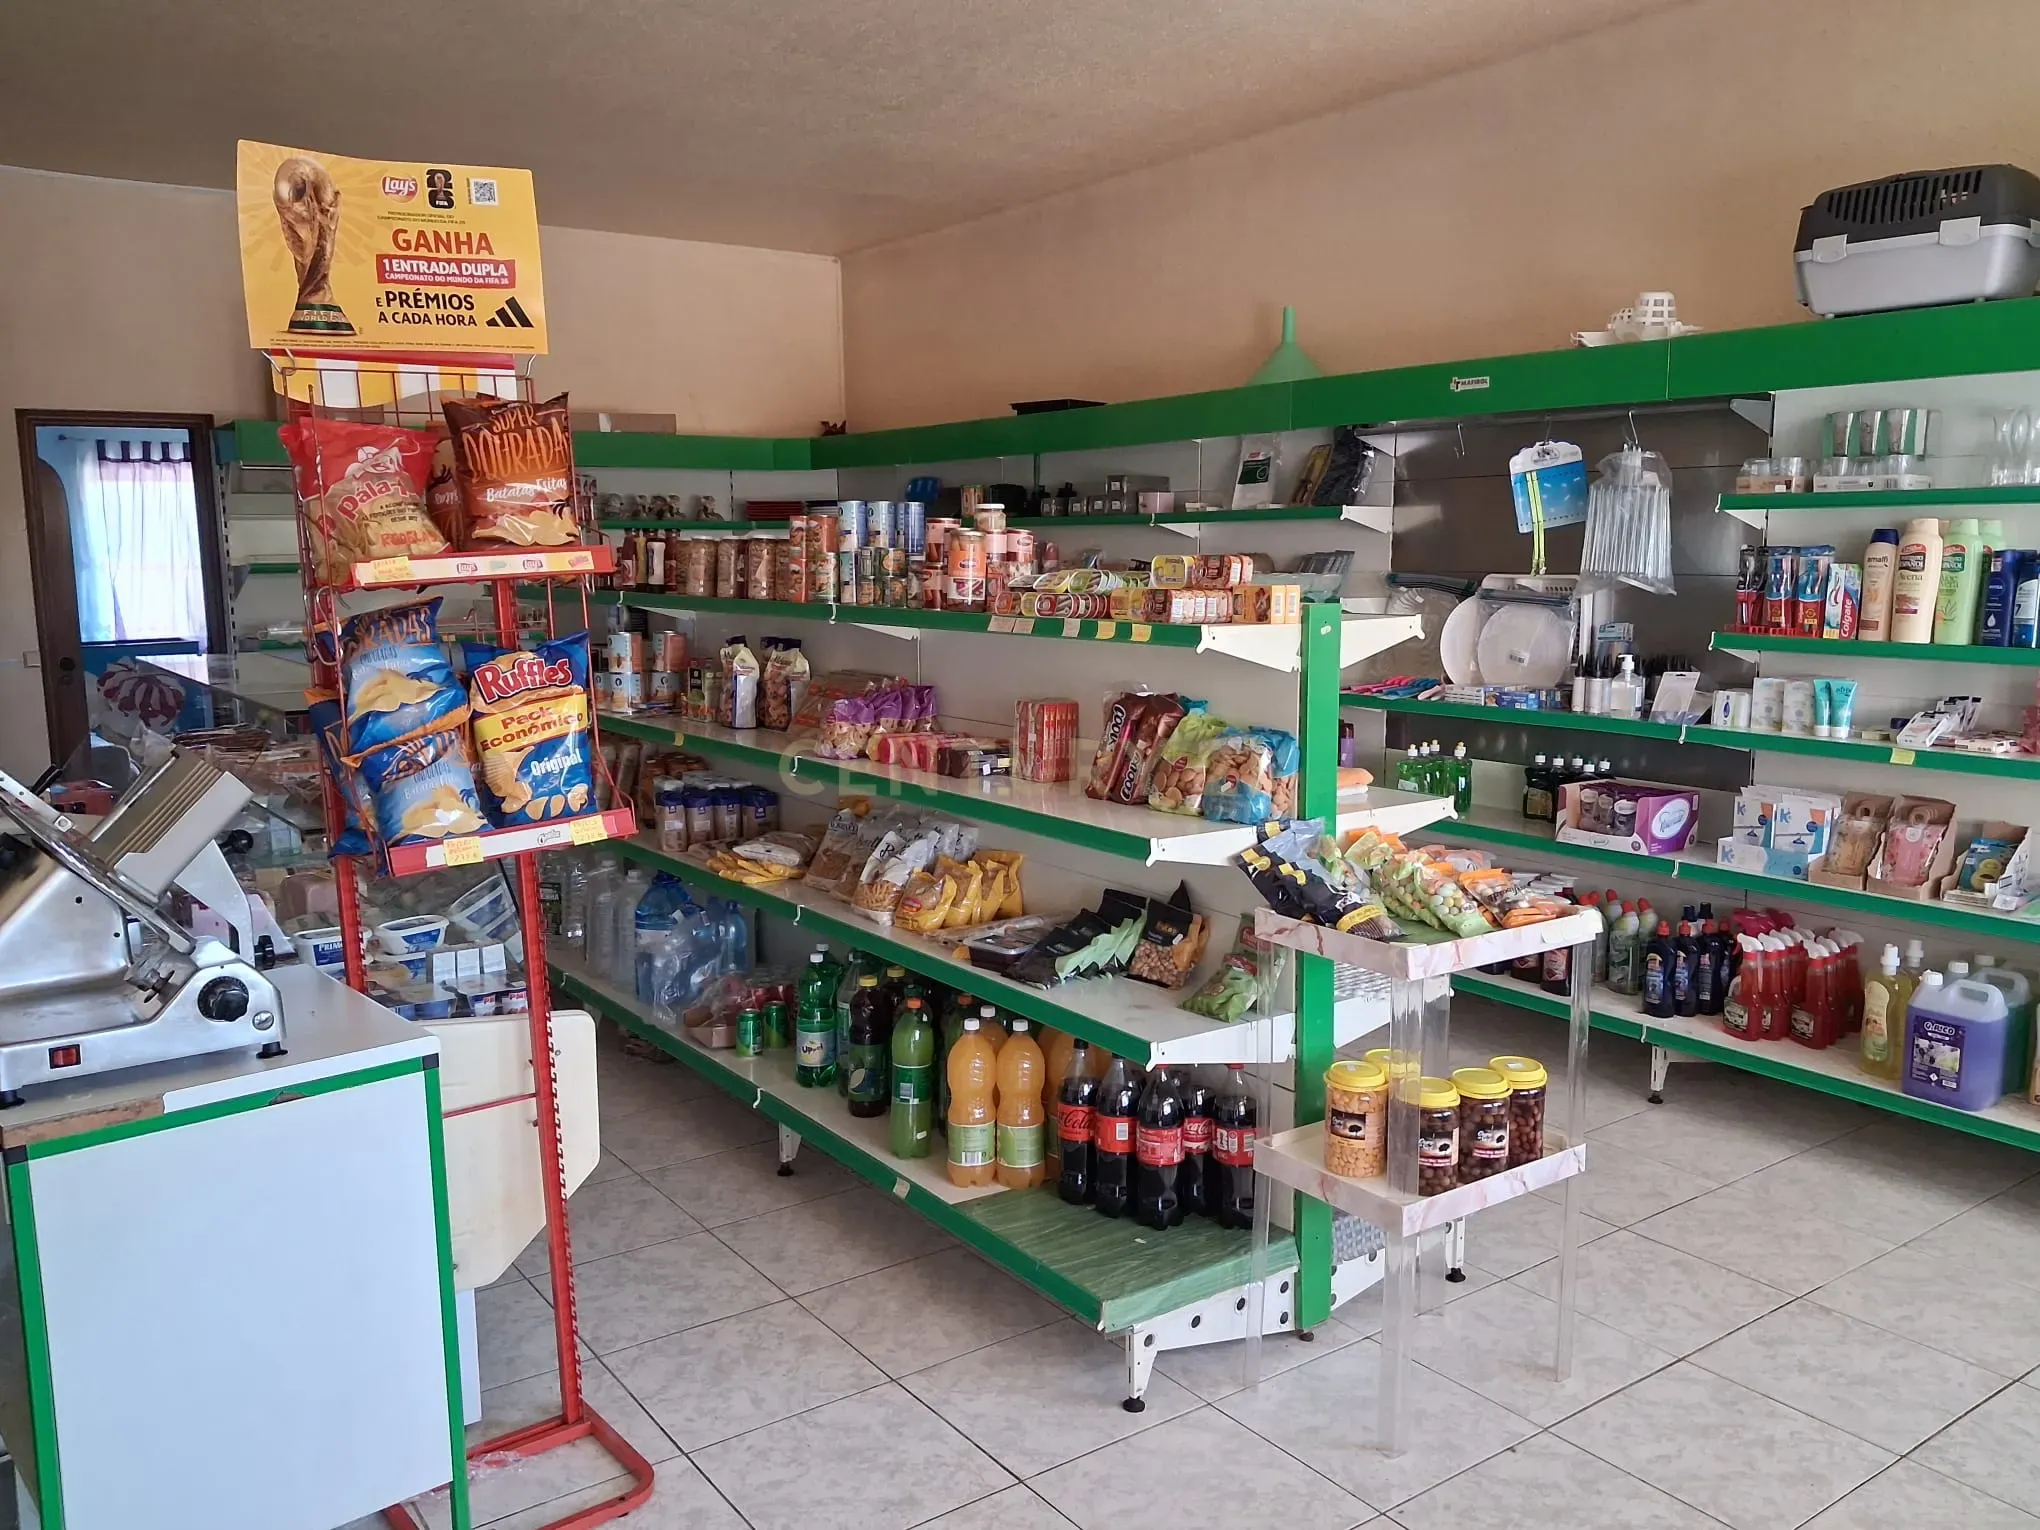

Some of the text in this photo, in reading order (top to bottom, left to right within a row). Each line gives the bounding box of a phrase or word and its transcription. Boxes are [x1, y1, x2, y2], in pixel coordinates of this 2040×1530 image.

[384, 176, 417, 196] Lay's
[392, 228, 494, 255] GANHA
[383, 259, 508, 276] 1 ENTRADA DUPLA
[385, 272, 434, 281] CAMPEONATO
[446, 276, 473, 284] MUNDO
[376, 288, 475, 311] E PRÉMIOS
[378, 312, 478, 327] A CADA HORA
[490, 403, 540, 432] SUPER
[486, 485, 536, 502] Batatas
[1841, 598, 1853, 638] Colgate
[474, 659, 572, 703] Ruffles
[501, 706, 554, 729] Pack
[480, 712, 584, 752] Económico
[531, 748, 583, 776] Original
